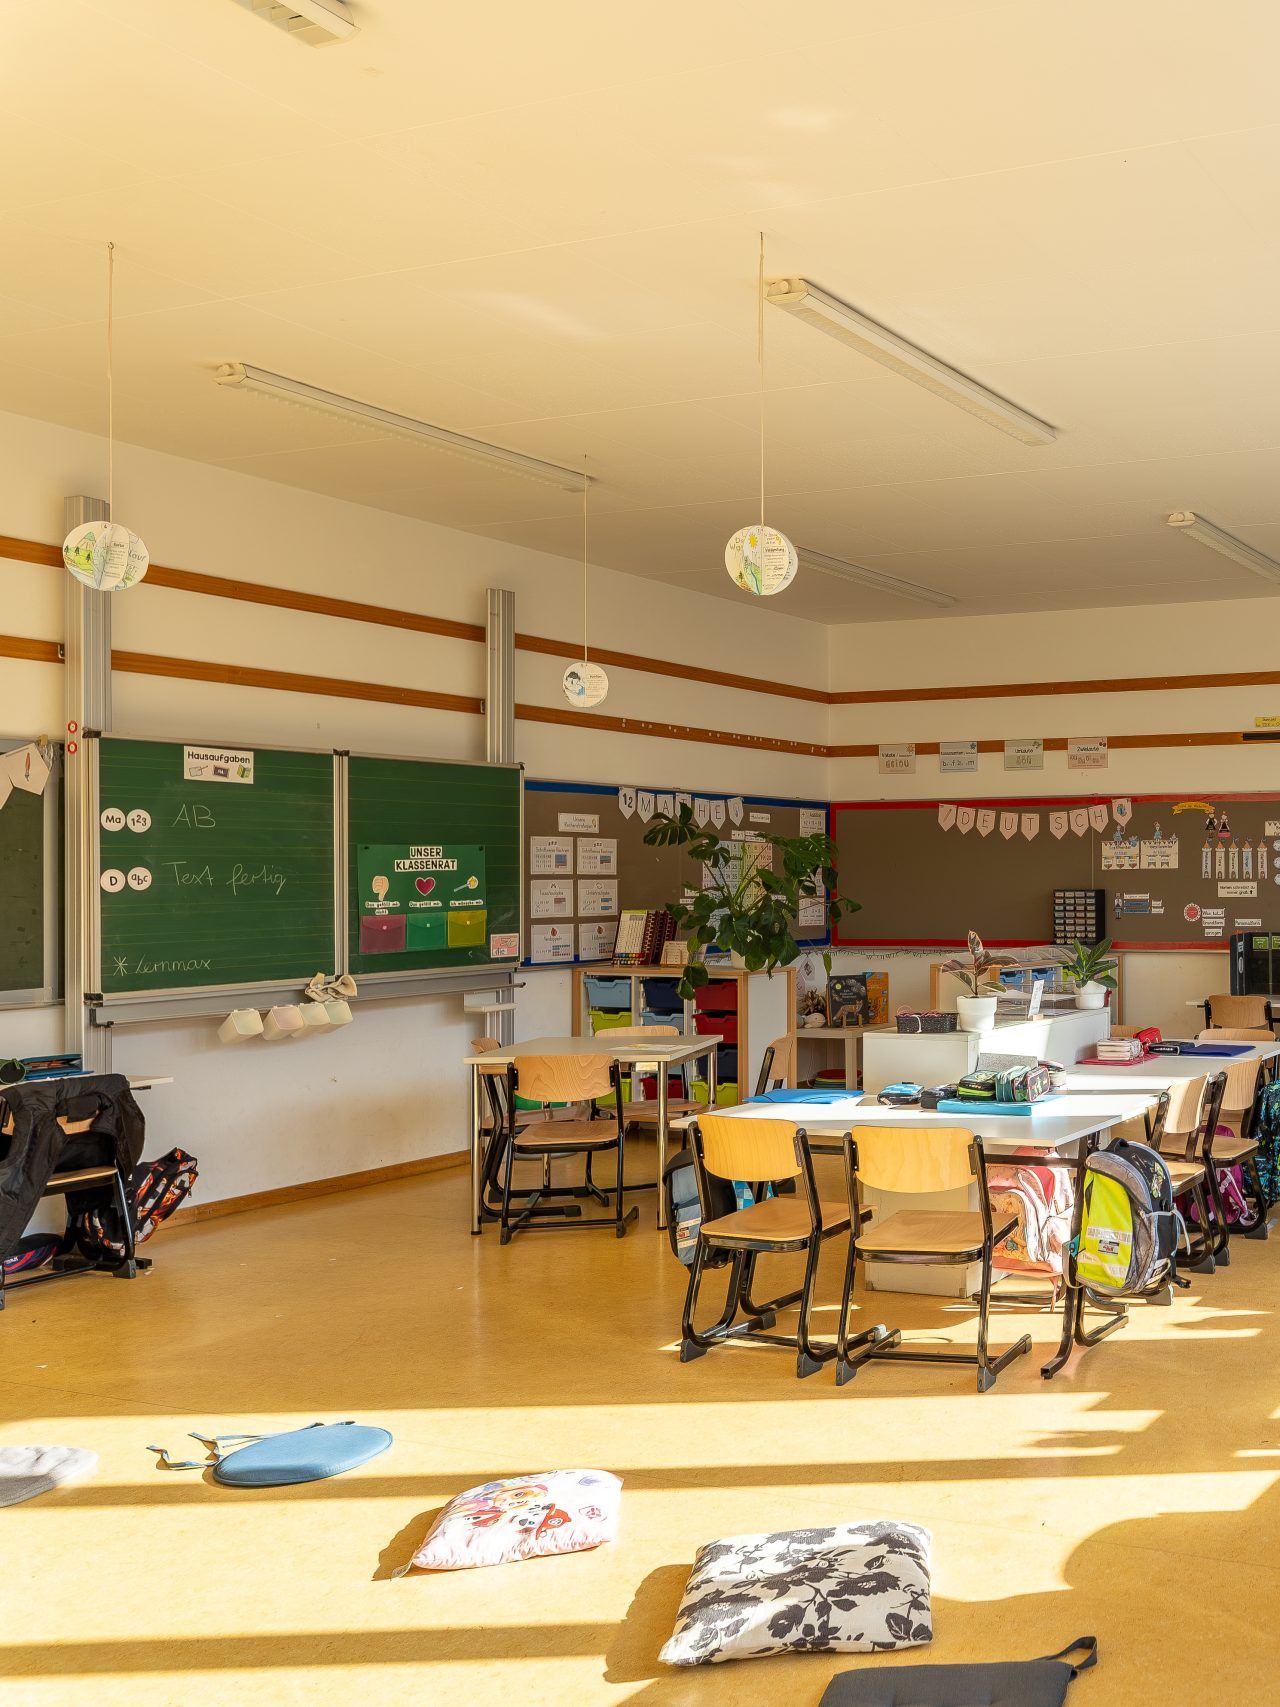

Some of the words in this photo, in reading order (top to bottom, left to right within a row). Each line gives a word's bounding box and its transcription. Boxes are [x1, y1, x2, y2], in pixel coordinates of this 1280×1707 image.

[187, 751, 251, 764] Hausaufgaben
[105, 815, 122, 825] Ma
[130, 814, 147, 827] 123
[171, 803, 216, 829] AB
[410, 847, 442, 857] UNSER
[395, 860, 456, 871] KLASSENRAT
[109, 876, 118, 886] D
[131, 873, 148, 886] abc
[161, 861, 214, 887] Text
[226, 863, 287, 896] fertig
